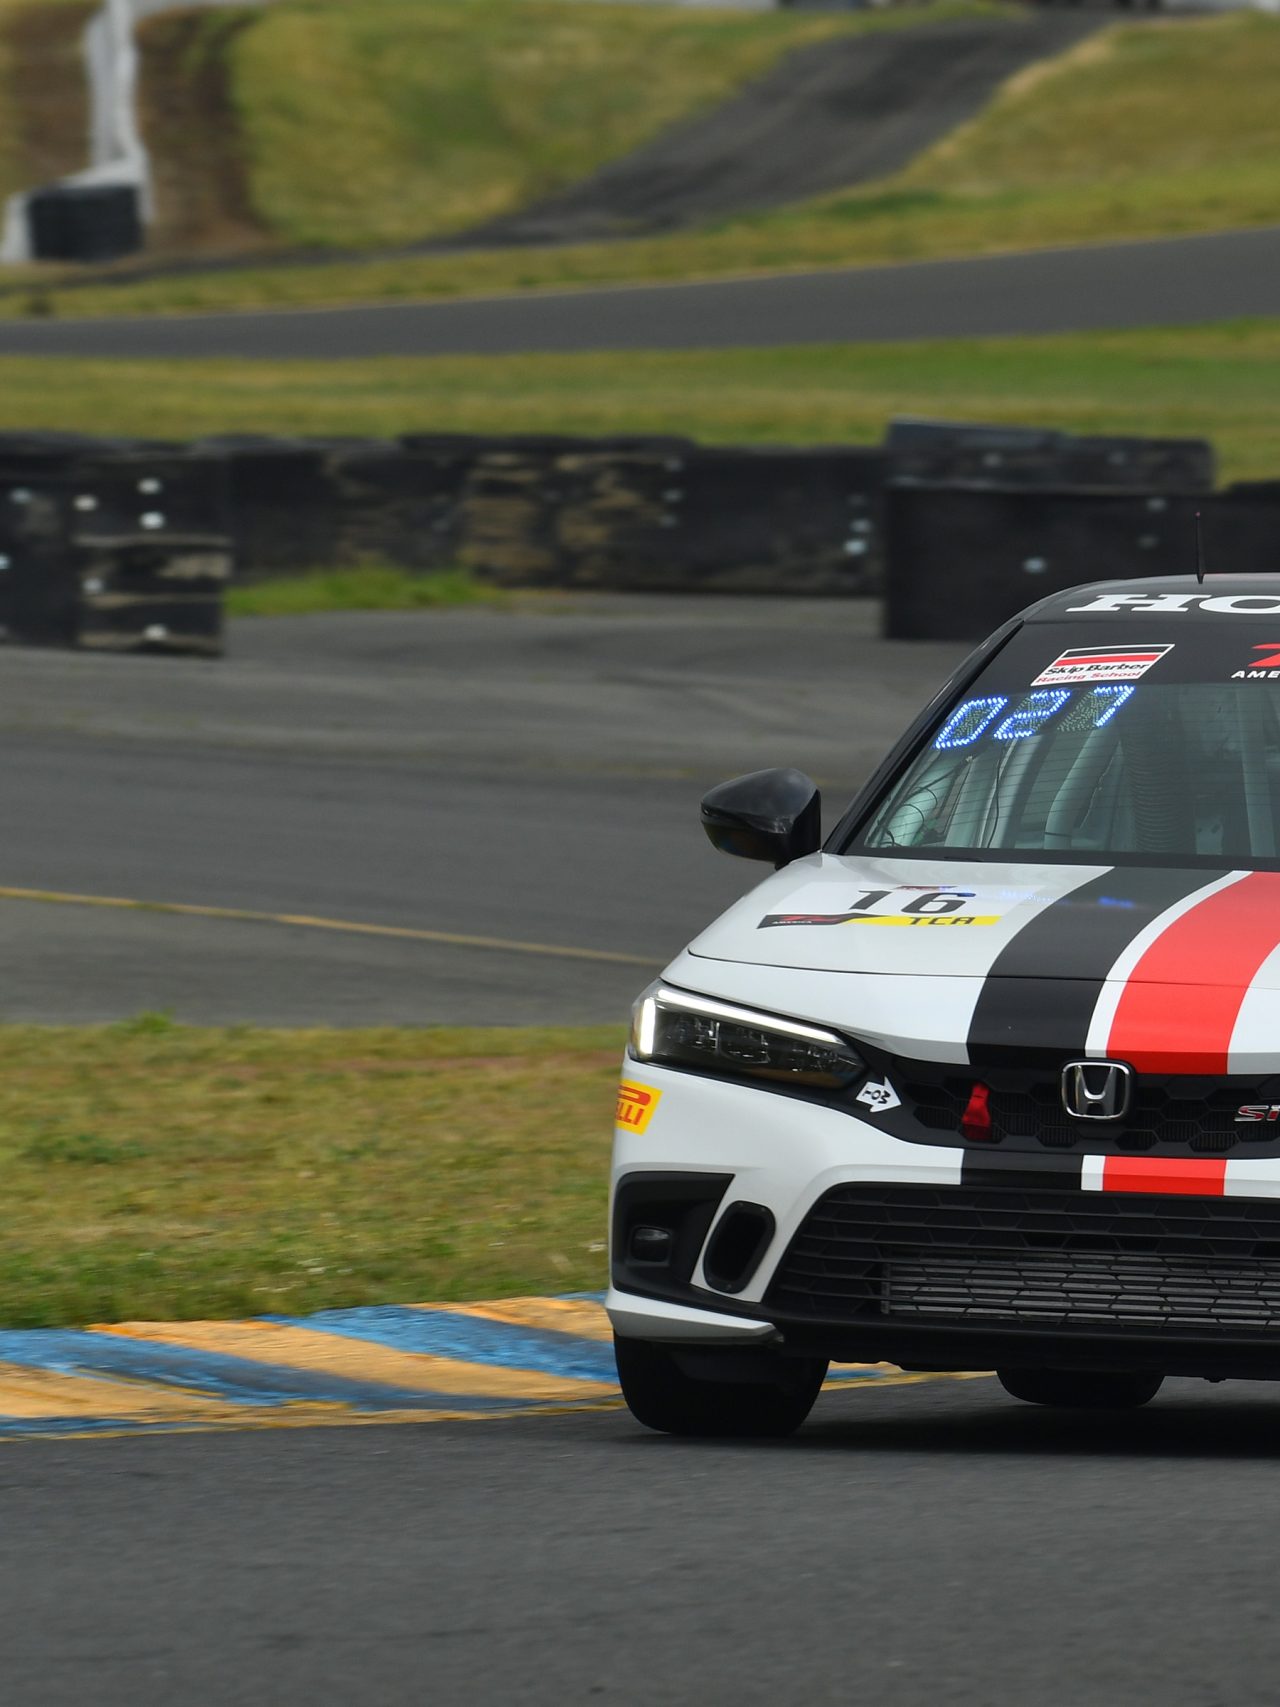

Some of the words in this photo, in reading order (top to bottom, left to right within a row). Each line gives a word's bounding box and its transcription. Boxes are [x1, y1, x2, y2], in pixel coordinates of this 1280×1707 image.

[1045, 665, 1084, 675] Skip
[1085, 663, 1150, 672] Barber
[1036, 674, 1086, 683] Racing
[933, 684, 1136, 749] 027
[848, 890, 976, 914] 16
[909, 917, 975, 925] TCA
[862, 1089, 891, 1105] TOW
